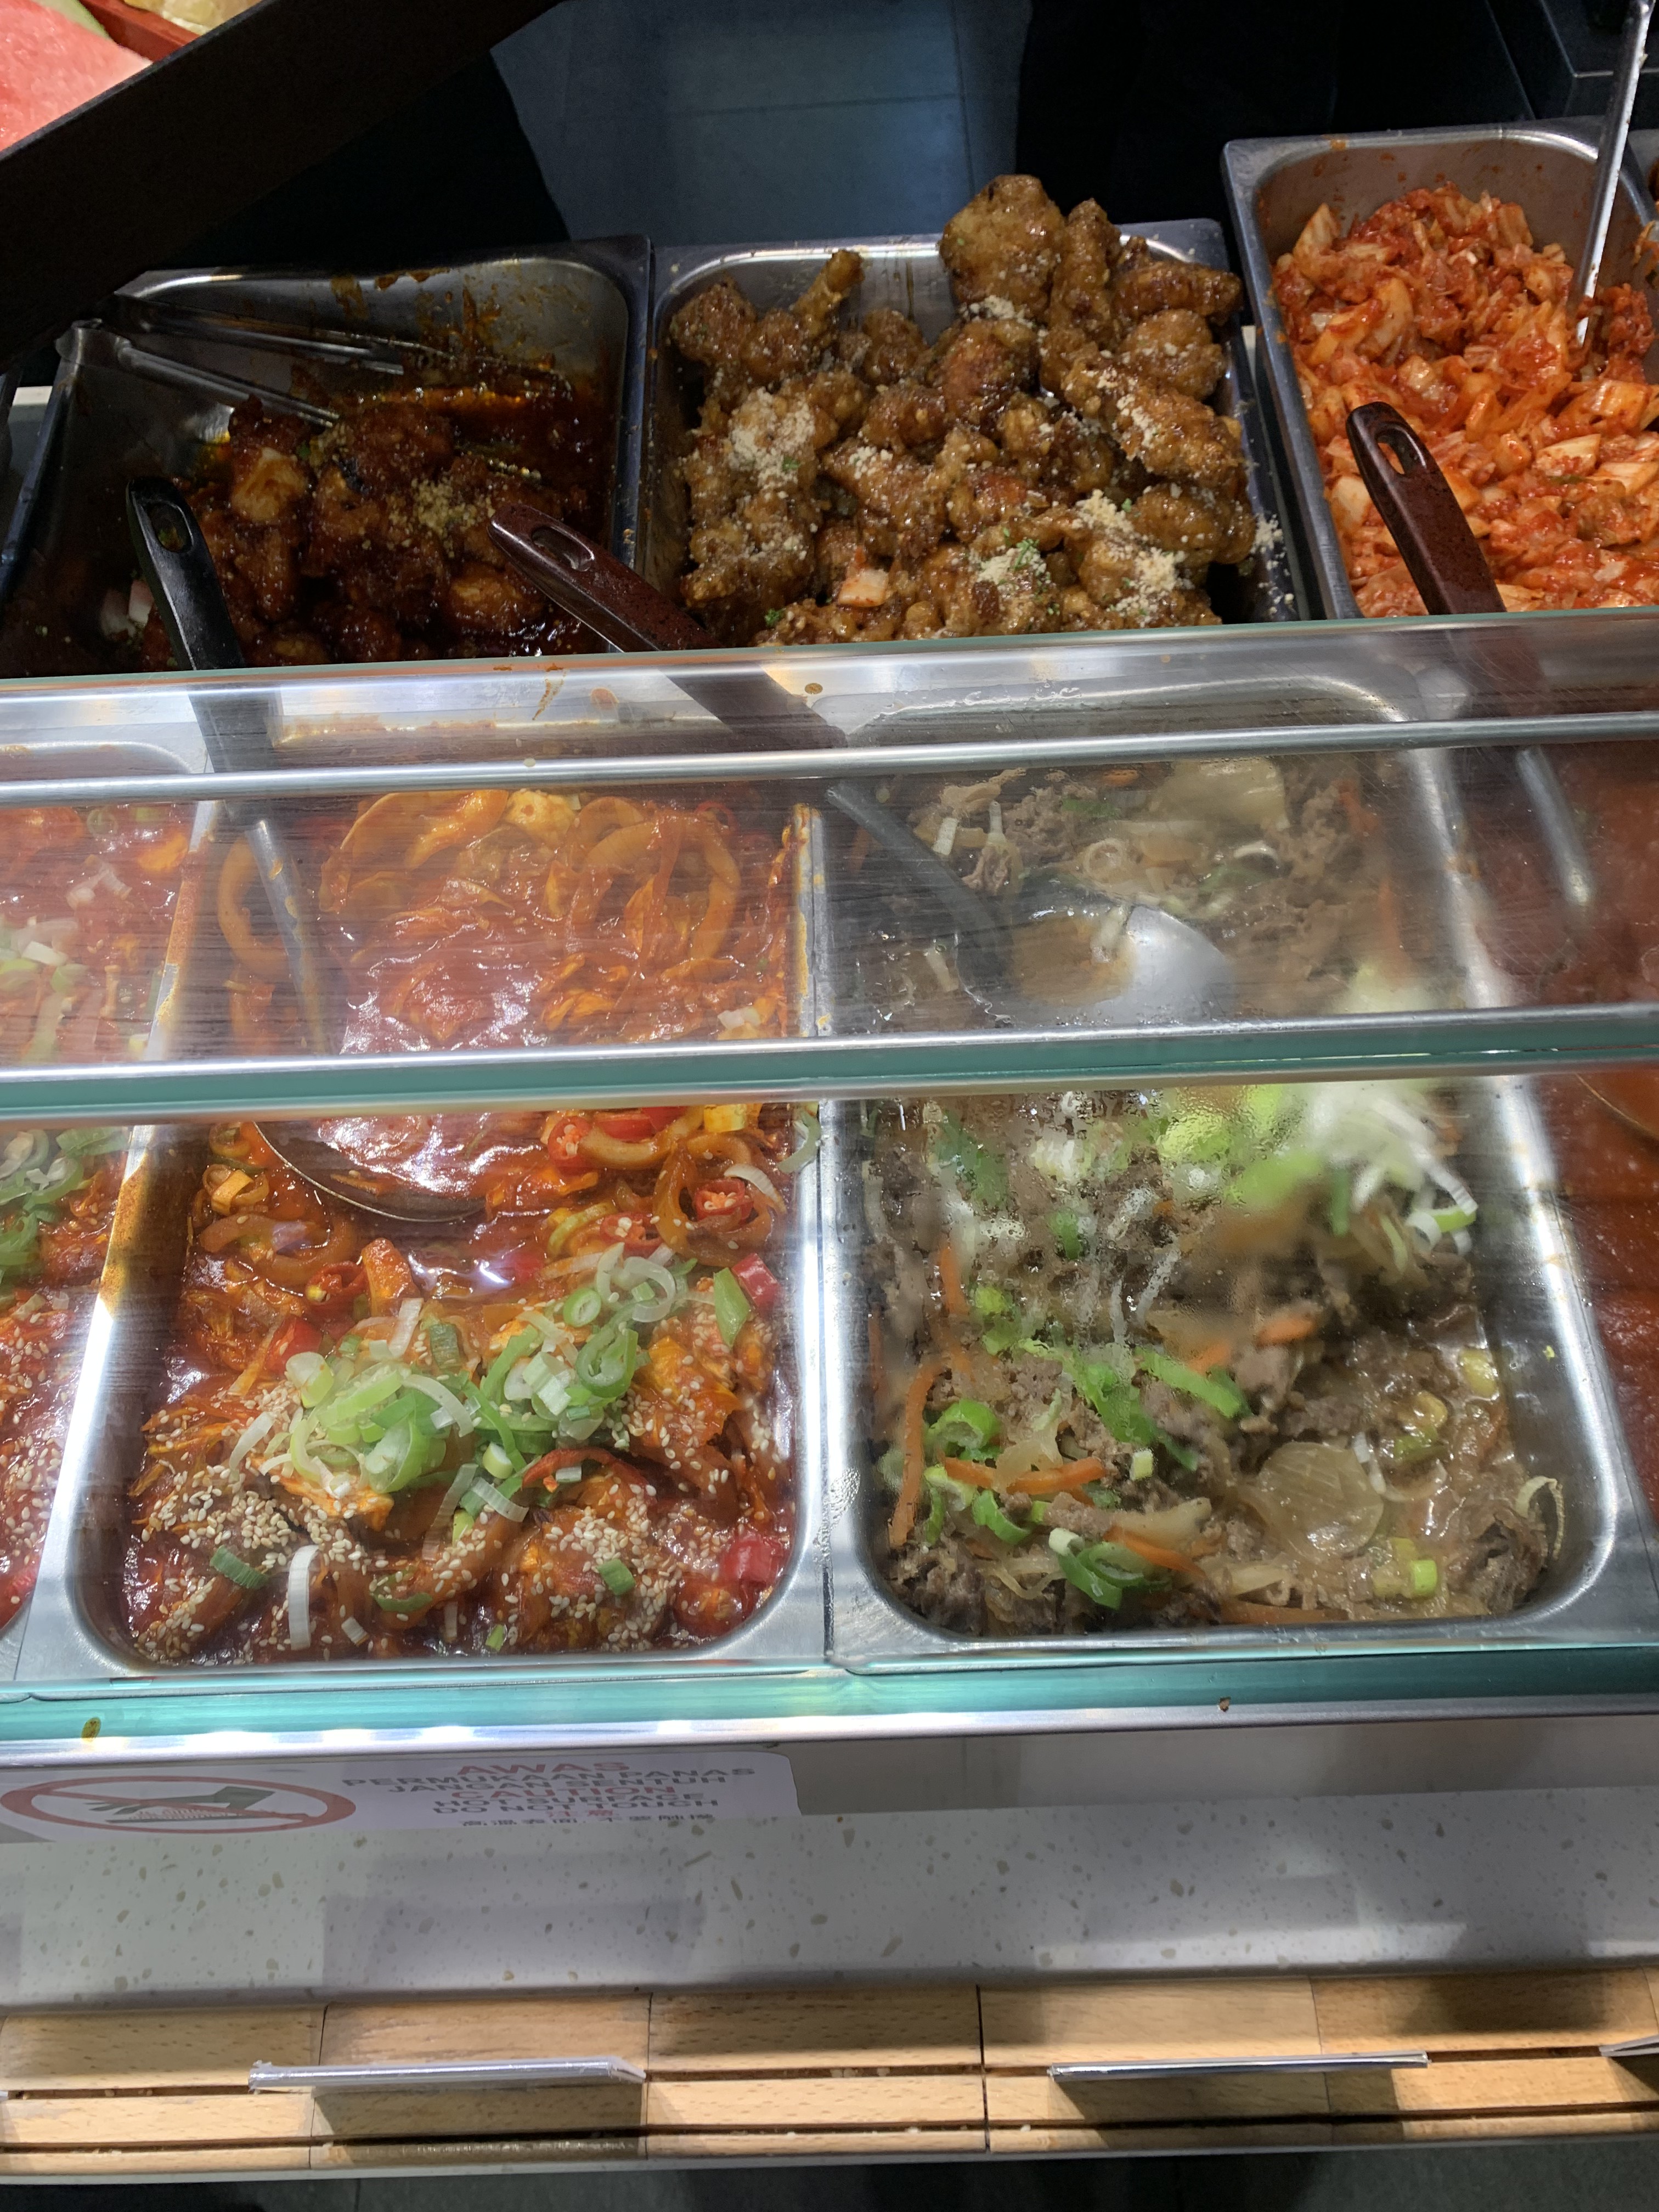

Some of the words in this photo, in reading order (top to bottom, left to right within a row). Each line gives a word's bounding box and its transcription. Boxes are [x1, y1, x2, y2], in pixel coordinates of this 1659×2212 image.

[457, 1762, 630, 1775] AWAS
[342, 1773, 605, 1786] PERMUKAAN
[619, 1768, 755, 1778] PANAS
[388, 1781, 551, 1792] JANGAN
[566, 1776, 726, 1787] SENTUH
[452, 1786, 676, 1799] CAUTION
[527, 1793, 703, 1804] SURFACE
[500, 1803, 575, 1812] NOT
[586, 1799, 718, 1809] TOUCH
